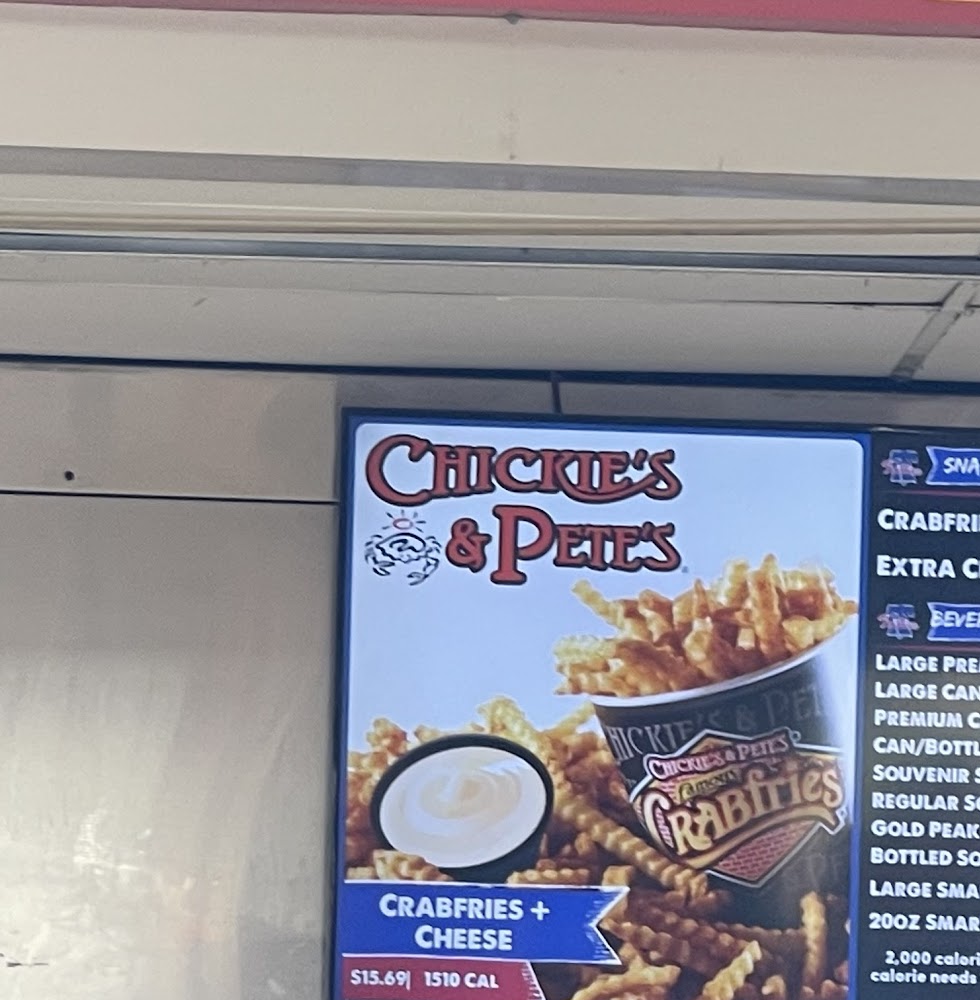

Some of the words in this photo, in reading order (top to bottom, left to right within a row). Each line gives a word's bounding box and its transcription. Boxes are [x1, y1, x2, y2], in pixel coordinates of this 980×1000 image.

[445, 518, 492, 573] &
[876, 555, 956, 579] EXTRA
[875, 654, 938, 674] LARGE
[874, 682, 938, 702] LARGE
[874, 709, 964, 731] PREMIUM
[872, 765, 971, 785] SOUVENIR
[871, 792, 960, 813] REGULAR
[870, 820, 926, 839] GOLD
[929, 821, 980, 841] PEAK
[869, 848, 953, 868] BOTTLED
[869, 880, 932, 900] LARGE
[379, 894, 524, 922] CRABFRIES
[529, 900, 551, 921] +
[414, 925, 513, 951] CHEESE
[885, 950, 931, 966] 2,000
[424, 970, 461, 988] 1510
[464, 972, 500, 989] CAL
[870, 969, 927, 984] calorie
[929, 970, 978, 986] needs
